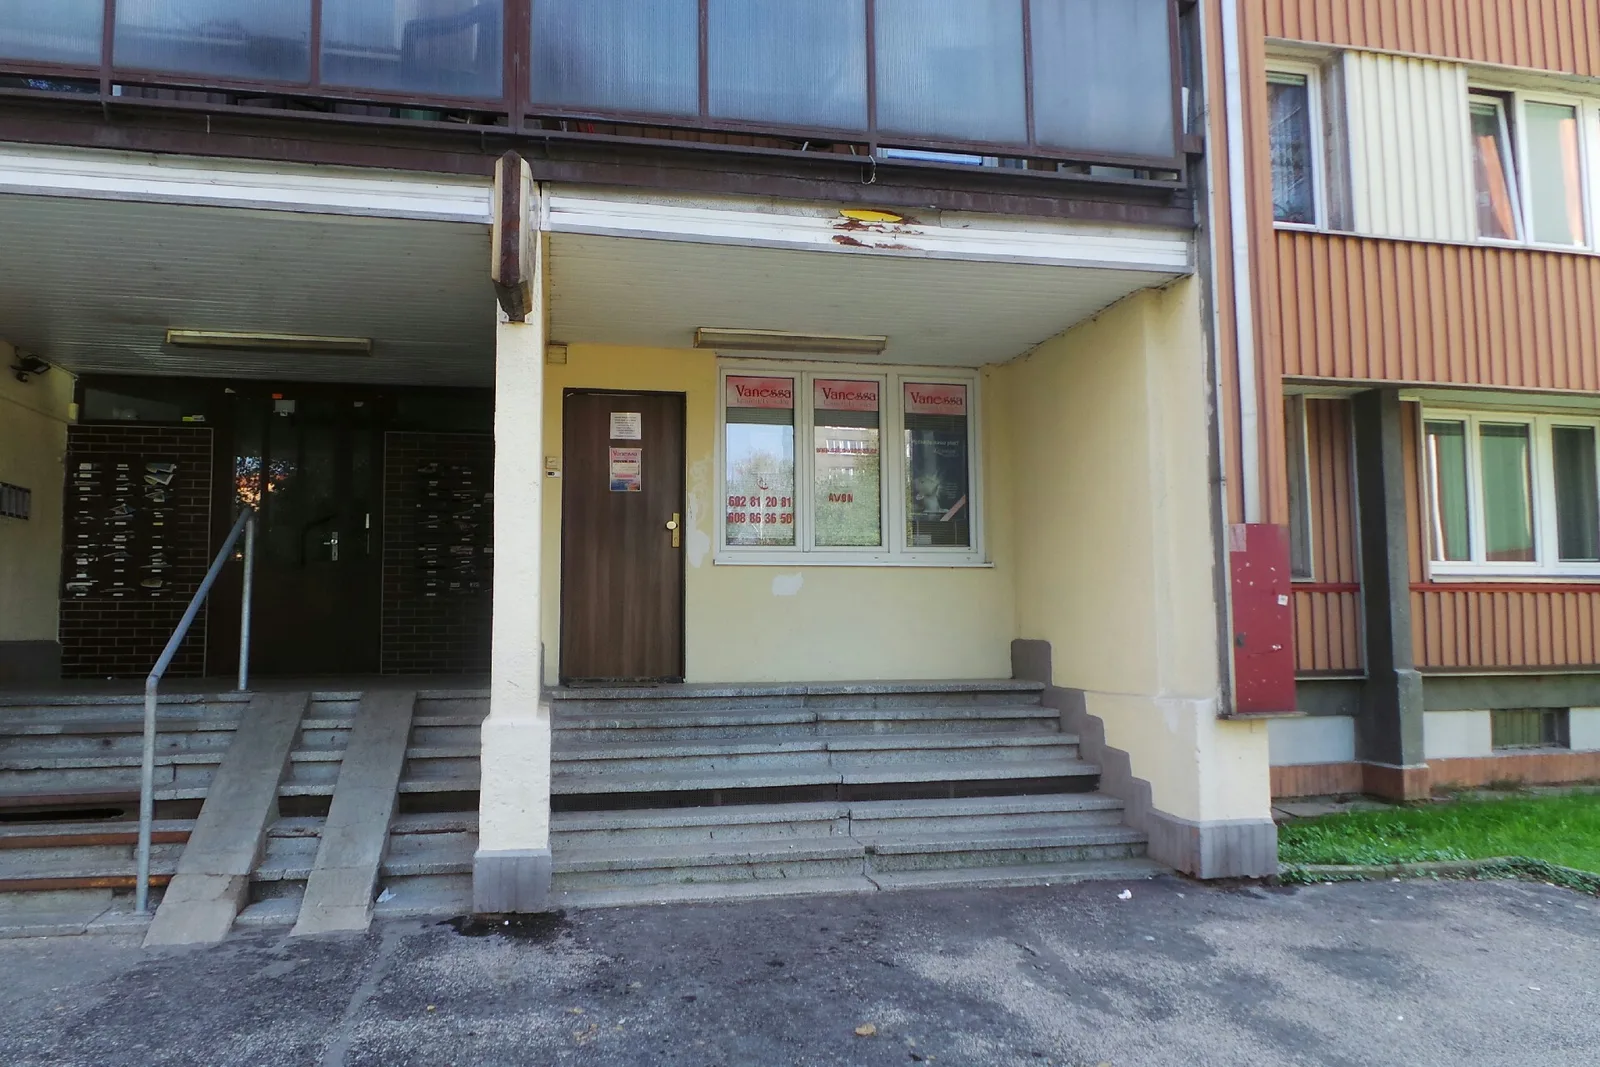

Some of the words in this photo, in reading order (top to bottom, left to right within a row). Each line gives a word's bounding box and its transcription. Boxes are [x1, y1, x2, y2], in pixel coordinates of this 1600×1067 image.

[735, 384, 791, 398] Vanessa
[822, 387, 876, 401] Vanessa
[910, 391, 963, 405] Vanessa
[728, 496, 746, 507] 602
[750, 496, 761, 507] 81
[765, 496, 778, 507] 20
[781, 496, 792, 507] 81
[828, 492, 854, 503] AVON
[728, 512, 746, 523] 608
[749, 512, 762, 524] 86
[765, 513, 777, 524] 36
[780, 513, 792, 524] 50
